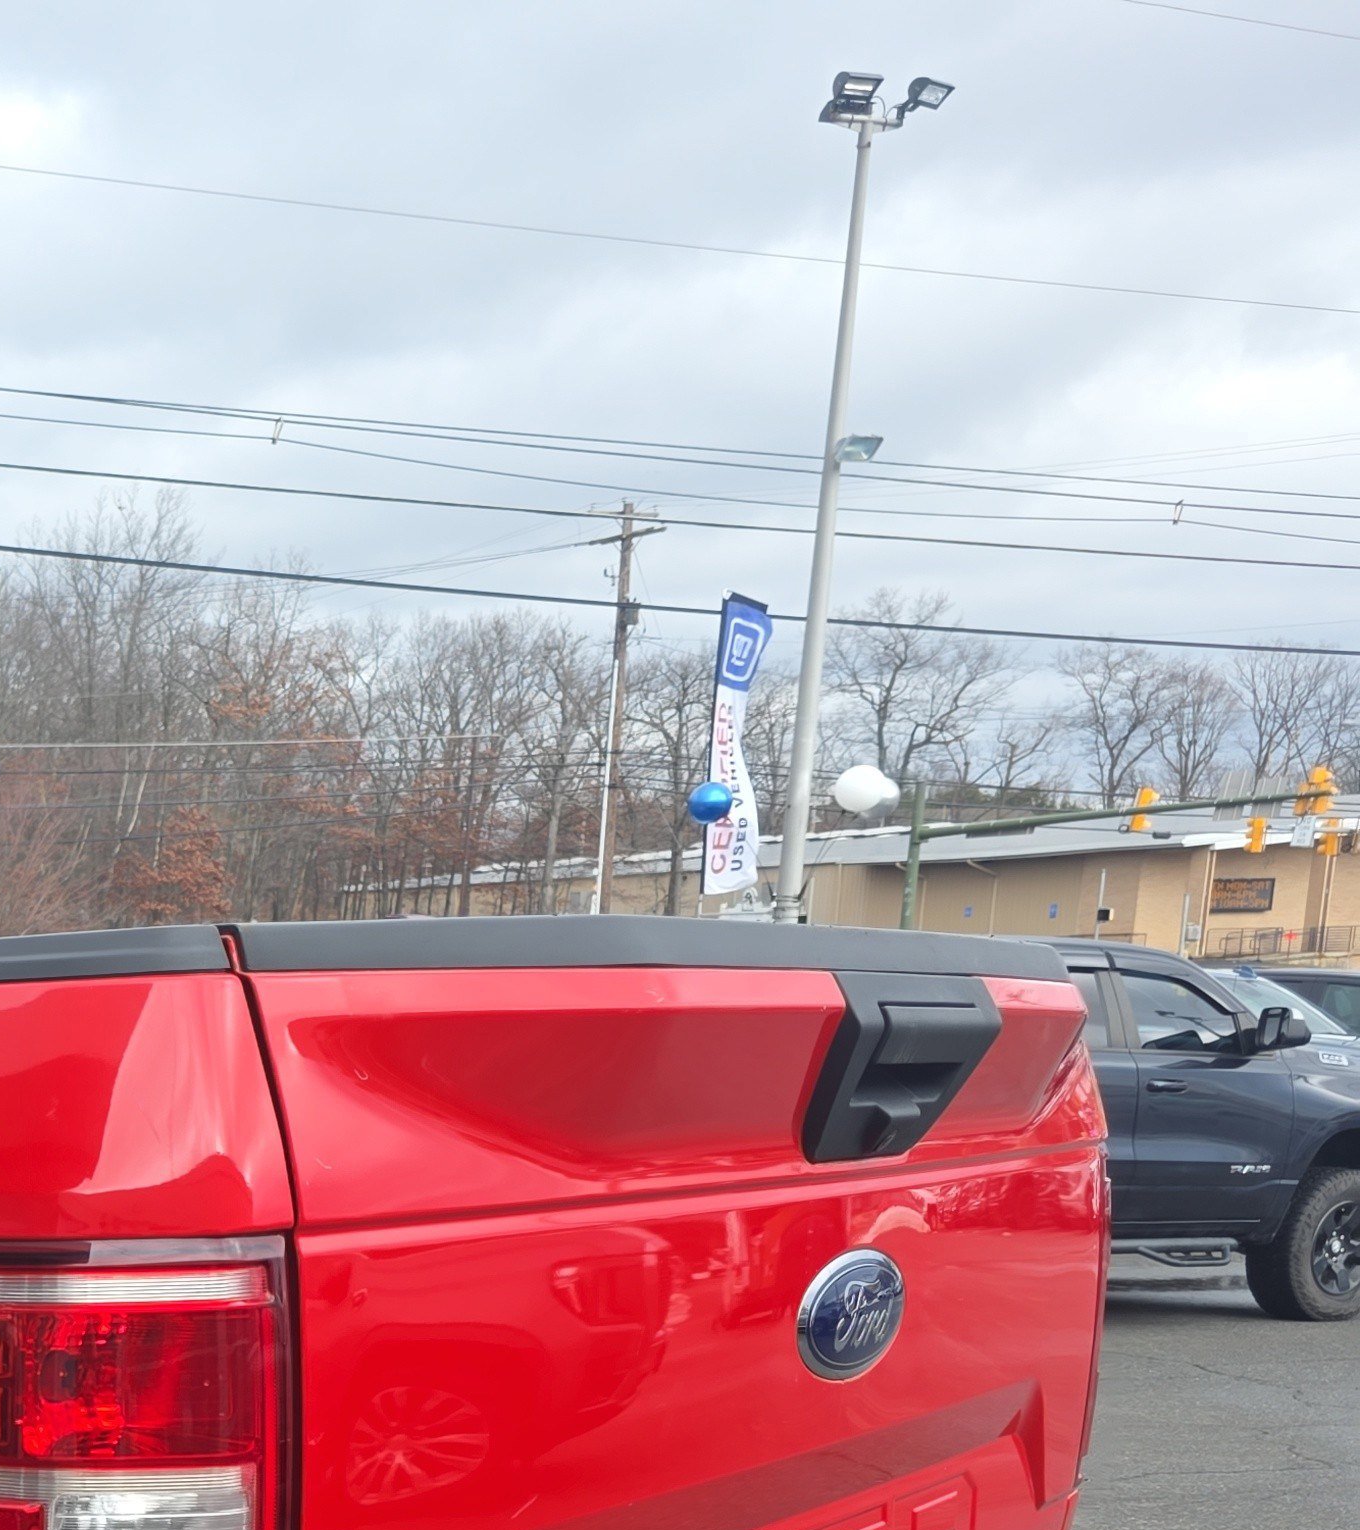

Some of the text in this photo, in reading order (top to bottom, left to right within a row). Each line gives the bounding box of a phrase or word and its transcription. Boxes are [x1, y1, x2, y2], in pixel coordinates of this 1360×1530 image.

[730, 817, 748, 871] USED
[1230, 1164, 1271, 1174] RAM
[833, 1278, 894, 1353] Ford
